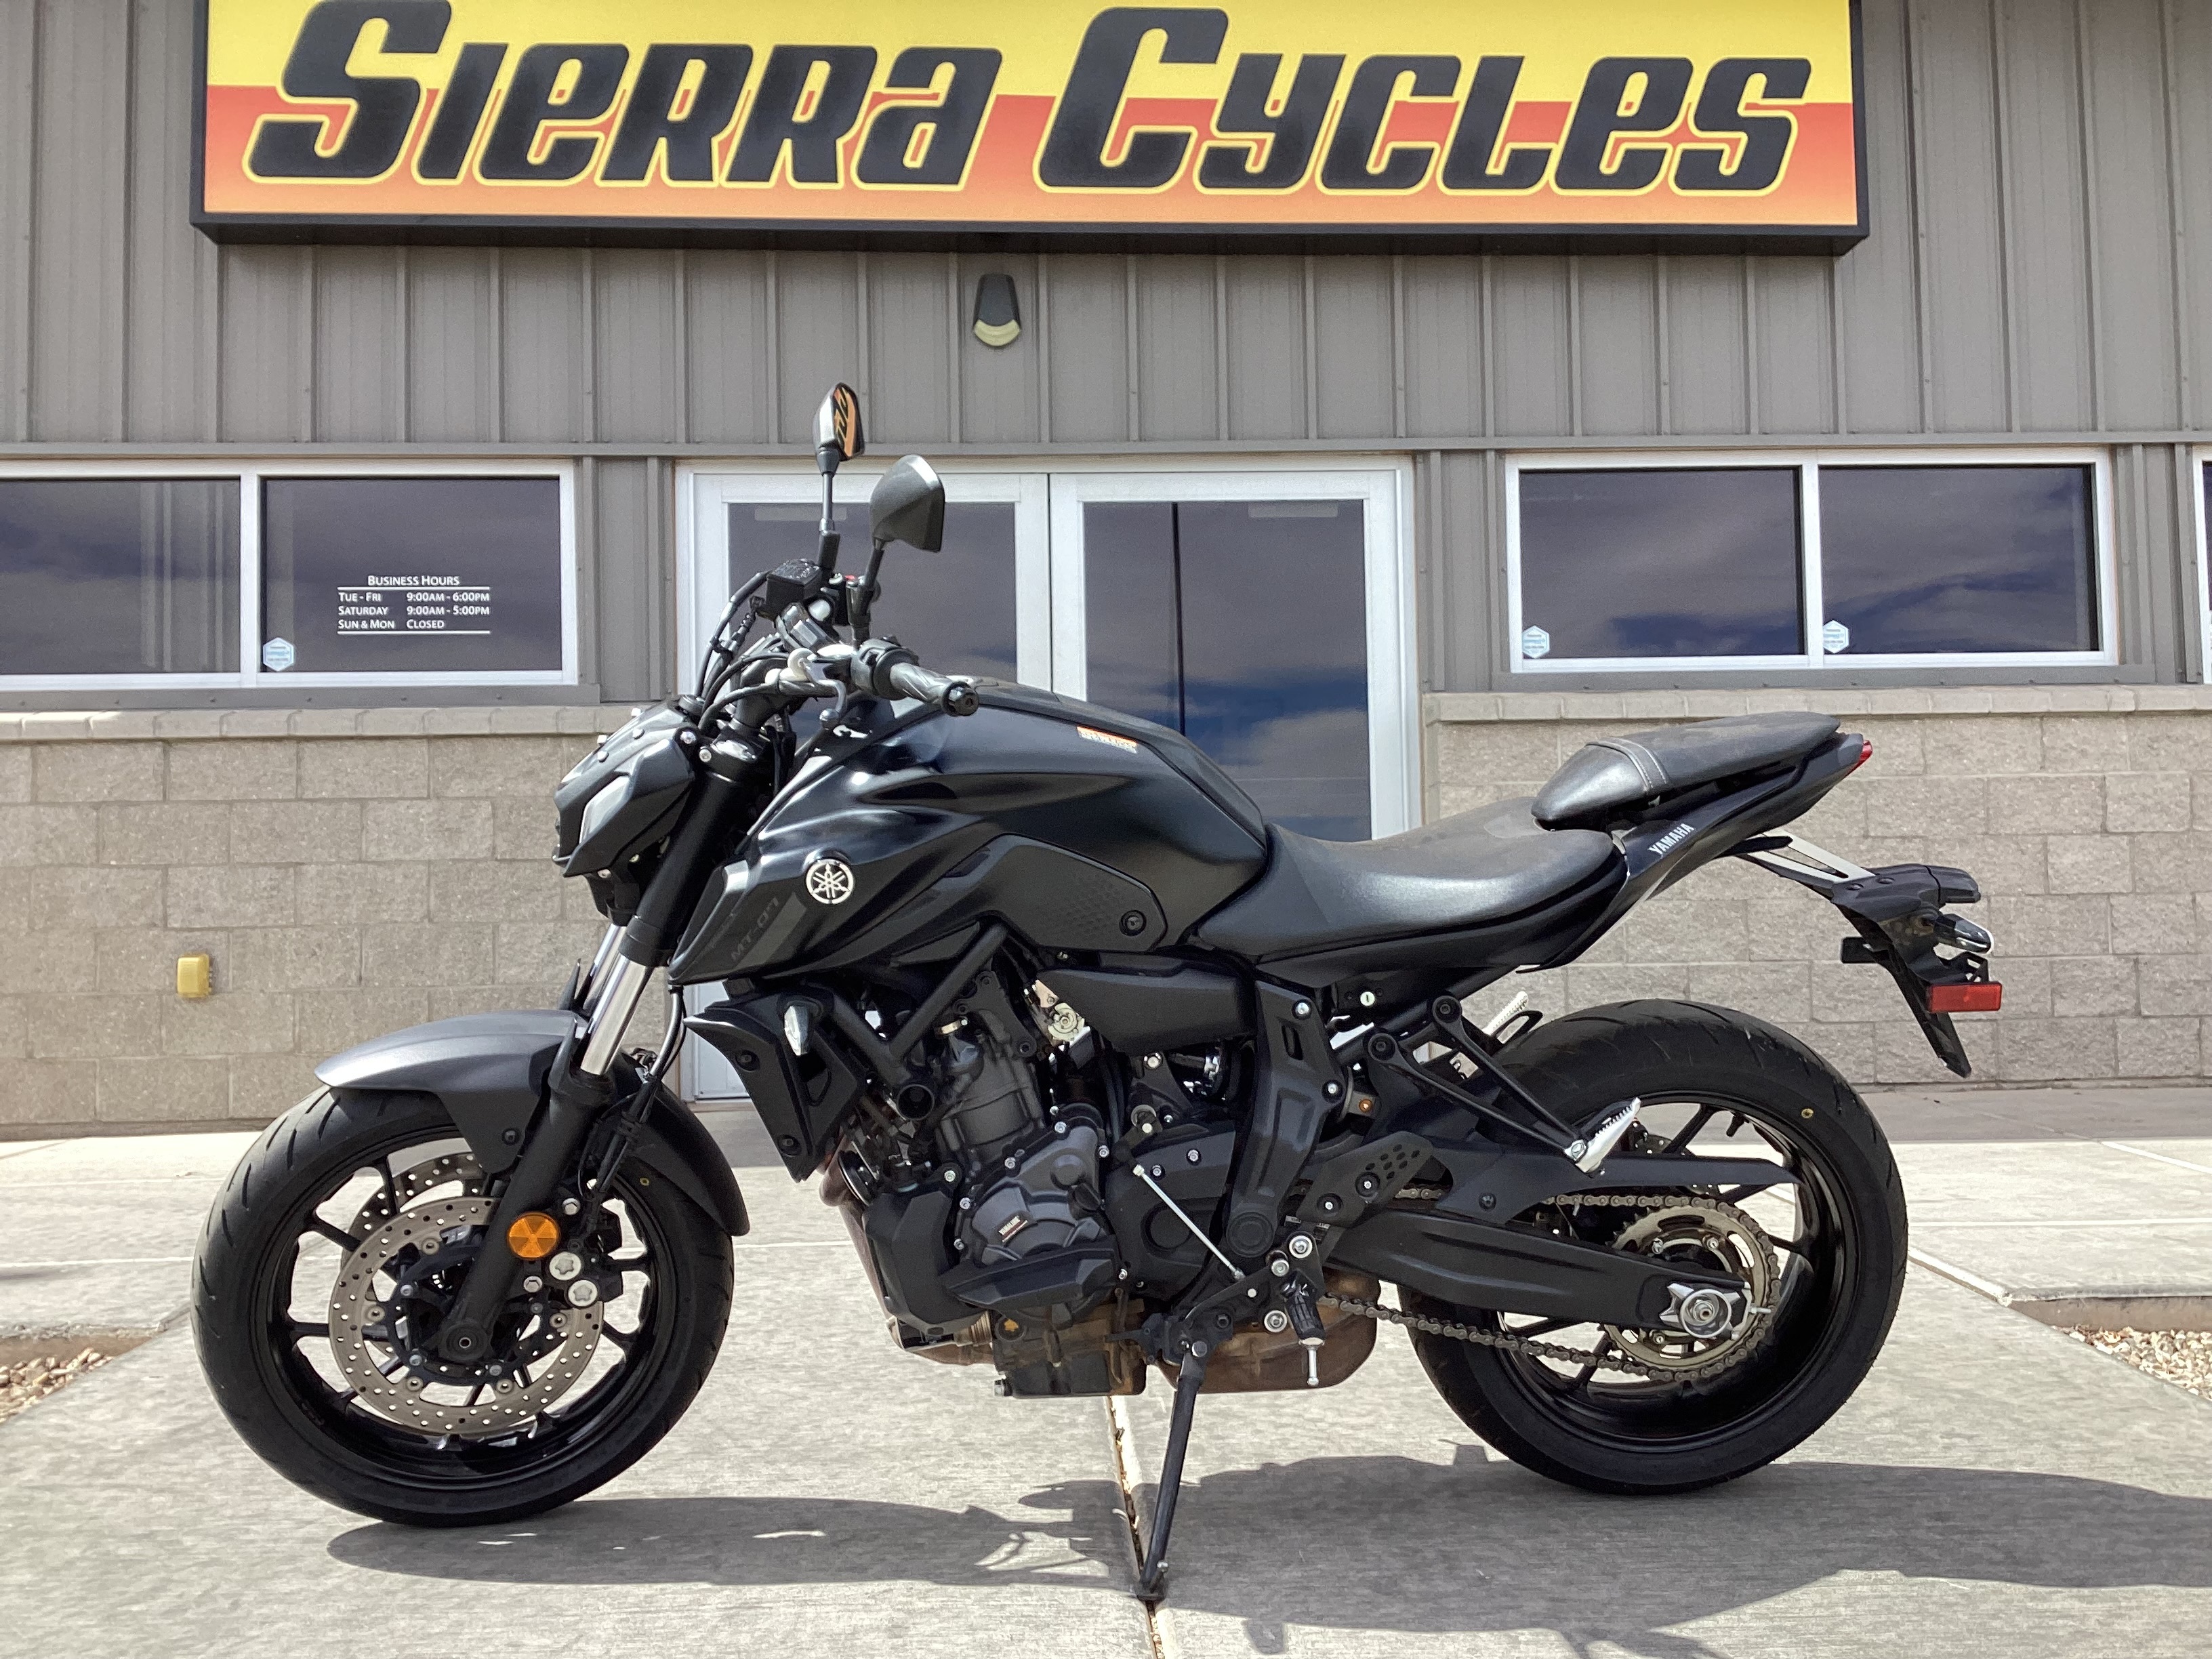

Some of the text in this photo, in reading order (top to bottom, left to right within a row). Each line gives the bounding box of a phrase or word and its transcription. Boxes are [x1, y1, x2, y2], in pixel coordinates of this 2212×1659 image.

[368, 575, 459, 586] BUSINESS HOURS
[339, 592, 358, 602] TUE
[366, 592, 382, 602] FRI
[407, 592, 445, 602] 9:00AM
[452, 592, 490, 602] 6:00PM
[338, 606, 388, 615] SATURDAY
[407, 606, 445, 615] 9:00AM
[452, 605, 490, 615] 5:00PM
[338, 619, 445, 629] SUN & MON CLOSED
[1647, 823, 1695, 855] YAMAHA
